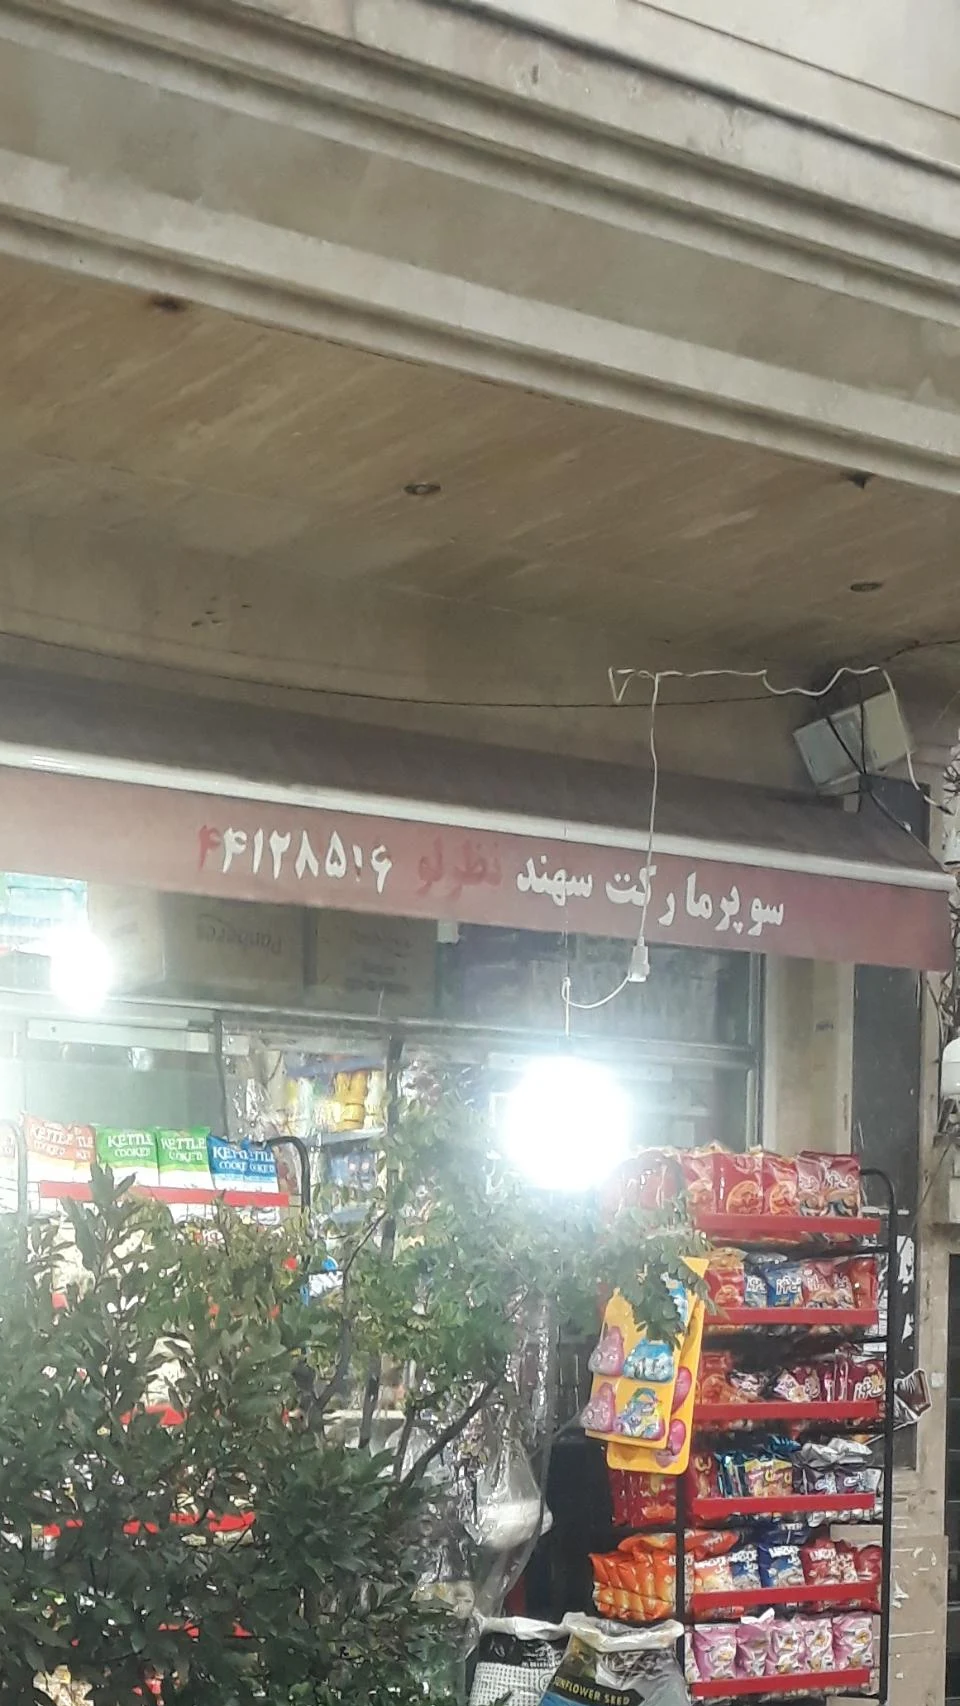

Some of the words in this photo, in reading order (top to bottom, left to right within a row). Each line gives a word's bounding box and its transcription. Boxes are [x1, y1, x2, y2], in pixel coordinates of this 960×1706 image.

[516, 855, 593, 907] سهند
[107, 1132, 155, 1149] KETTLE
[161, 1137, 208, 1151] KETTLE
[604, 1693, 630, 1706] SEED
